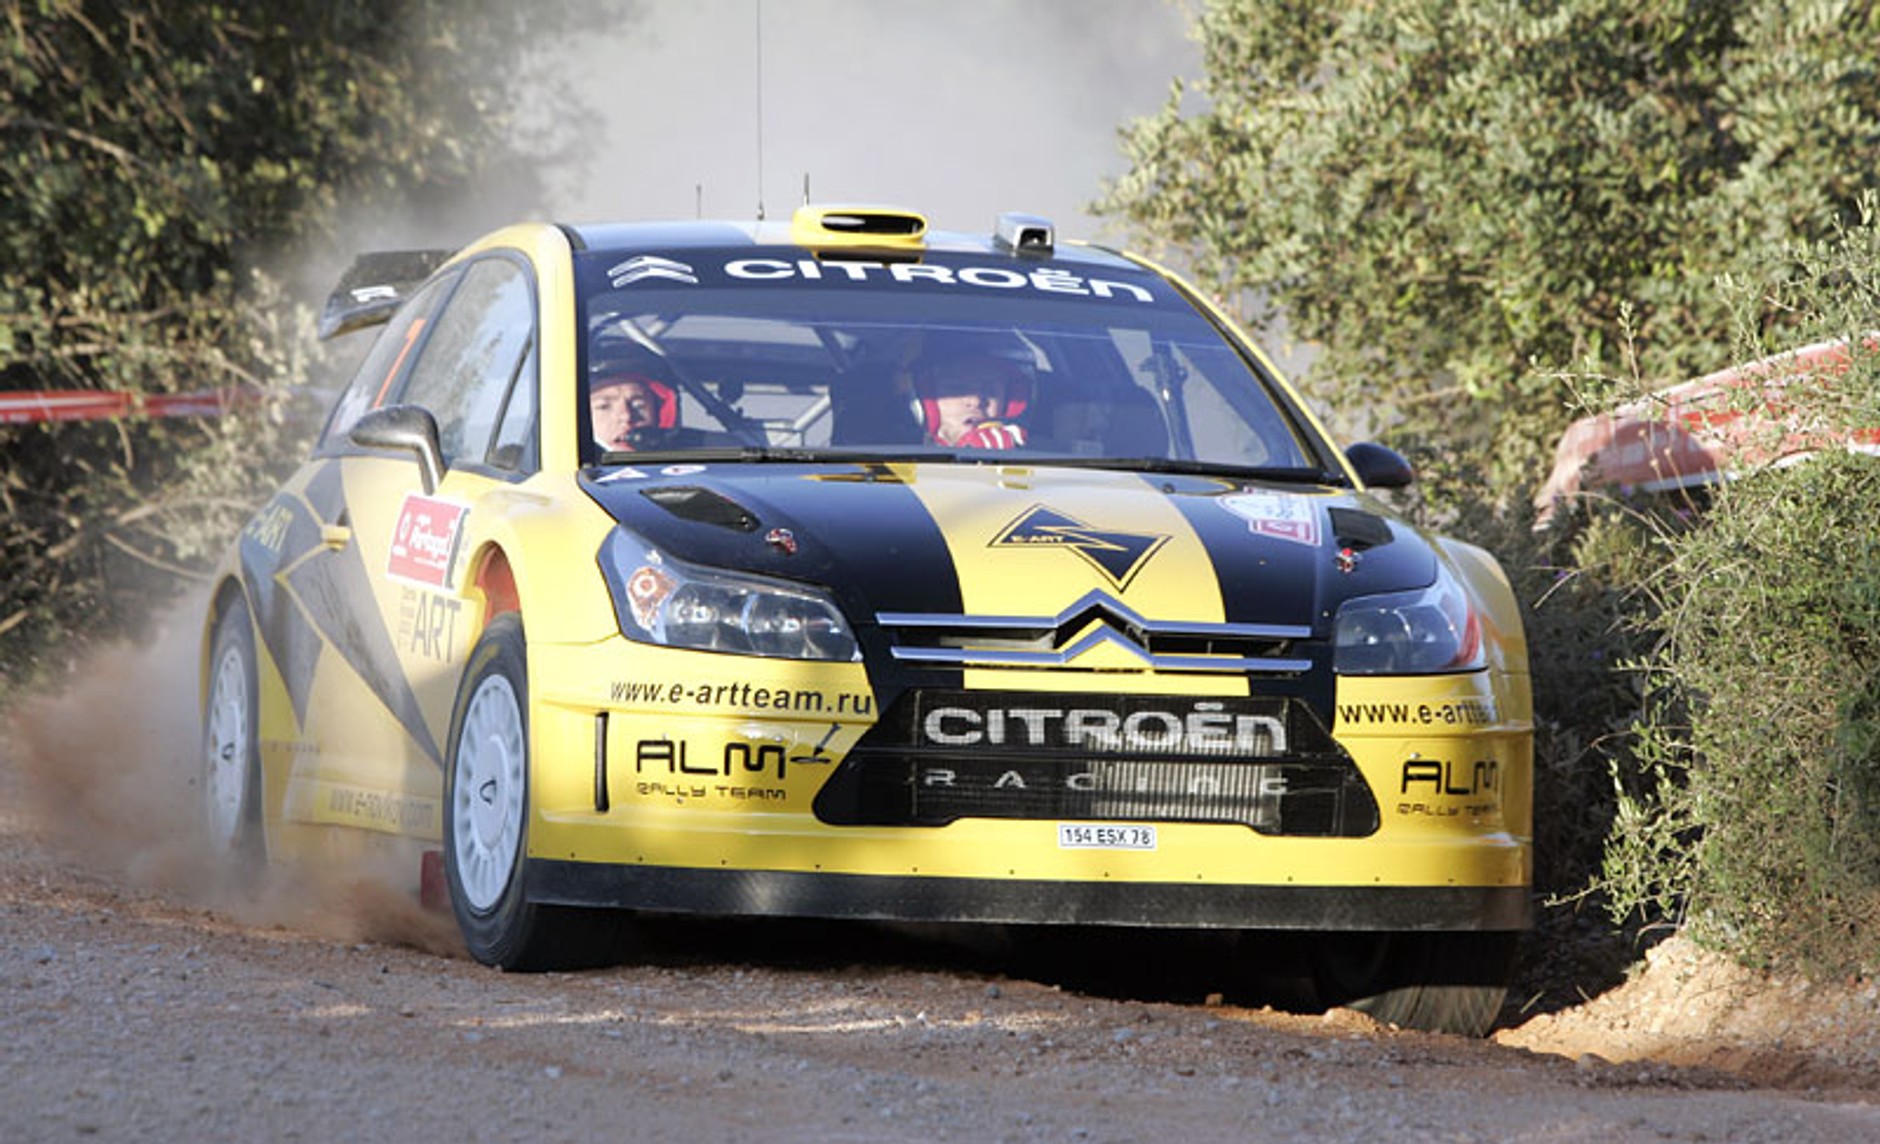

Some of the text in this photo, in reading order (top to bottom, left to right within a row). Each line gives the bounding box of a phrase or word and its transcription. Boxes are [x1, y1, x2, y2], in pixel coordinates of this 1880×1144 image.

[610, 681, 873, 715] www.e-artteam.ru
[636, 739, 786, 780] ALM
[636, 782, 787, 801] RALLY TEAM
[1065, 828, 1151, 845] 154 ESX 78
